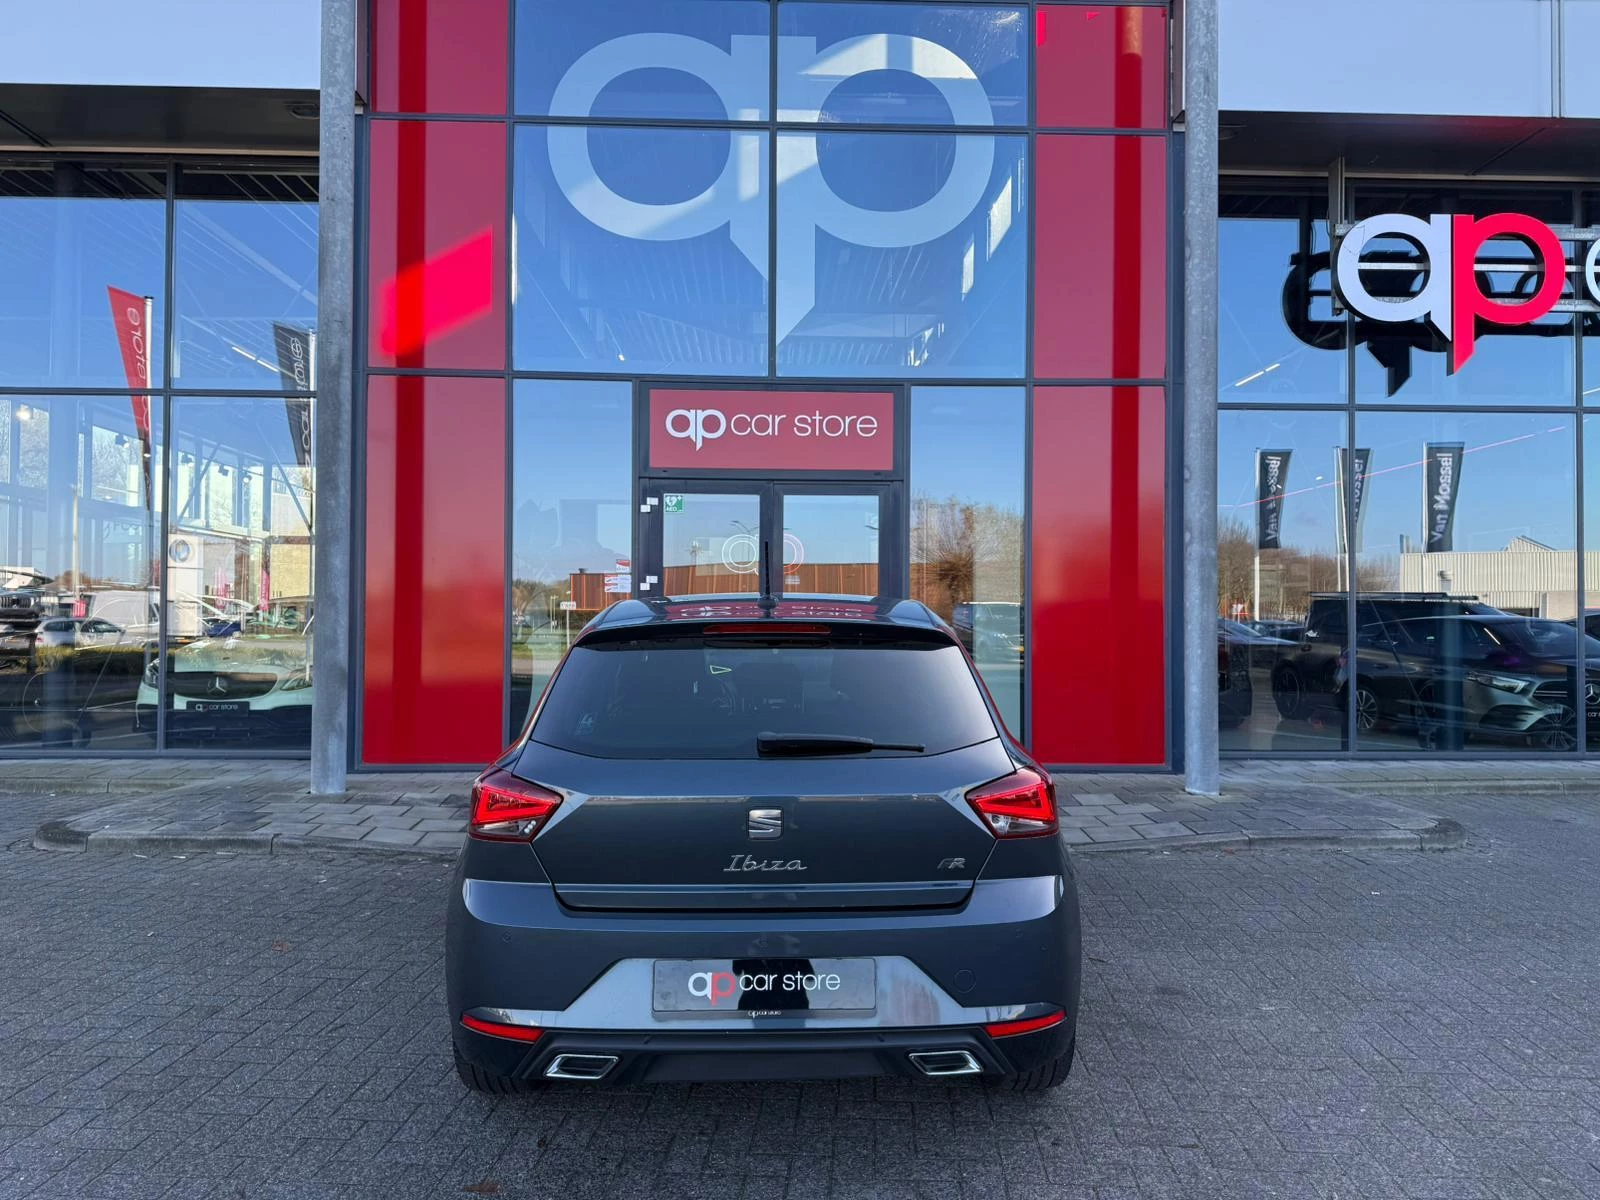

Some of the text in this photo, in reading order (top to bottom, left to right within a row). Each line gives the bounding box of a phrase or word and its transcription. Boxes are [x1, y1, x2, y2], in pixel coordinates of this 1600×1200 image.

[547, 33, 995, 346] ap
[1337, 213, 1566, 374] ap
[665, 409, 878, 451] ap car store
[1430, 453, 1453, 543] Van Mossel
[723, 854, 808, 872] Ibiza
[936, 857, 966, 869] FR
[687, 971, 841, 1007] ap car store
